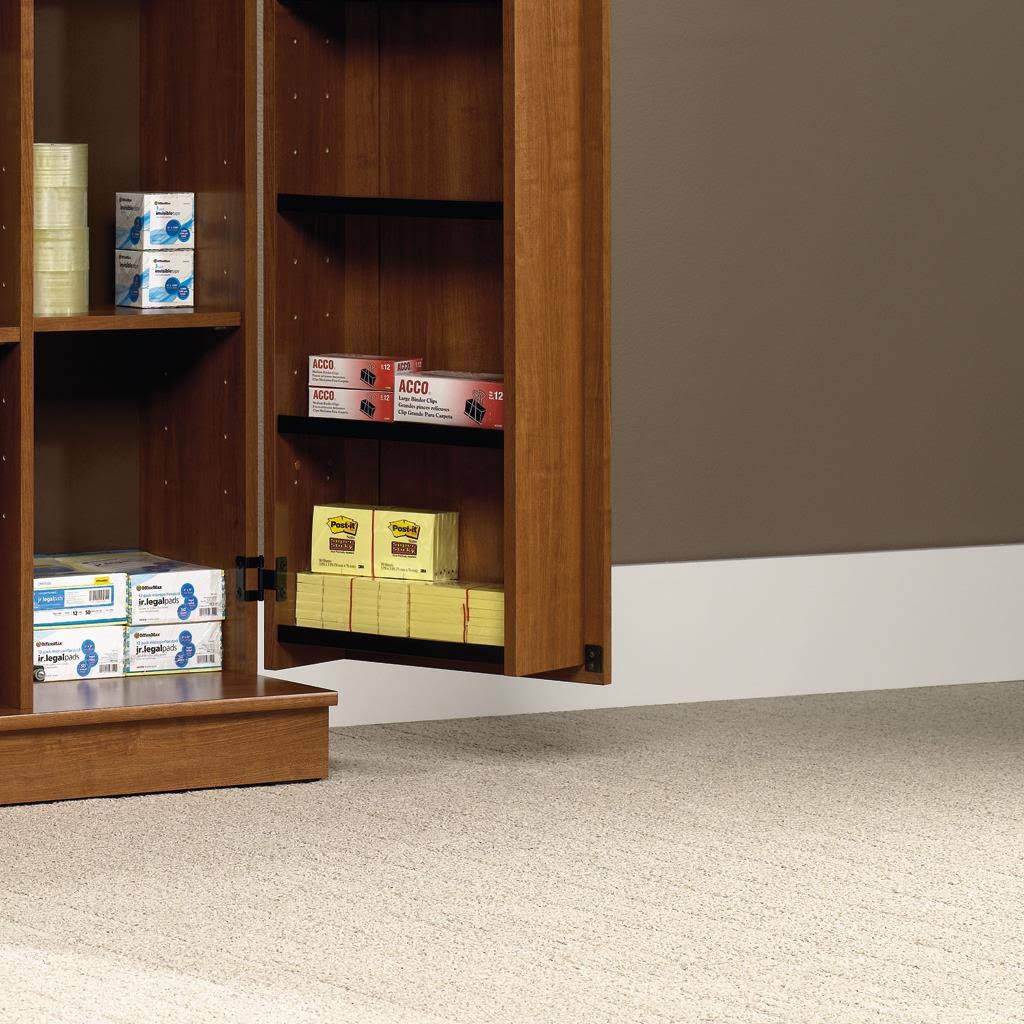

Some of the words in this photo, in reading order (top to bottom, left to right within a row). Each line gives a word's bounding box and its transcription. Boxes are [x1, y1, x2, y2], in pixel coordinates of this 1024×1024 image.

[313, 359, 334, 370] ACCO
[398, 362, 410, 371] ACCO
[399, 380, 429, 394] ACCO
[313, 390, 334, 400] ACCO
[494, 391, 504, 400] 12
[331, 521, 355, 529] Post-it
[393, 525, 417, 533] Post-it
[136, 645, 177, 655] jr.legalpads
